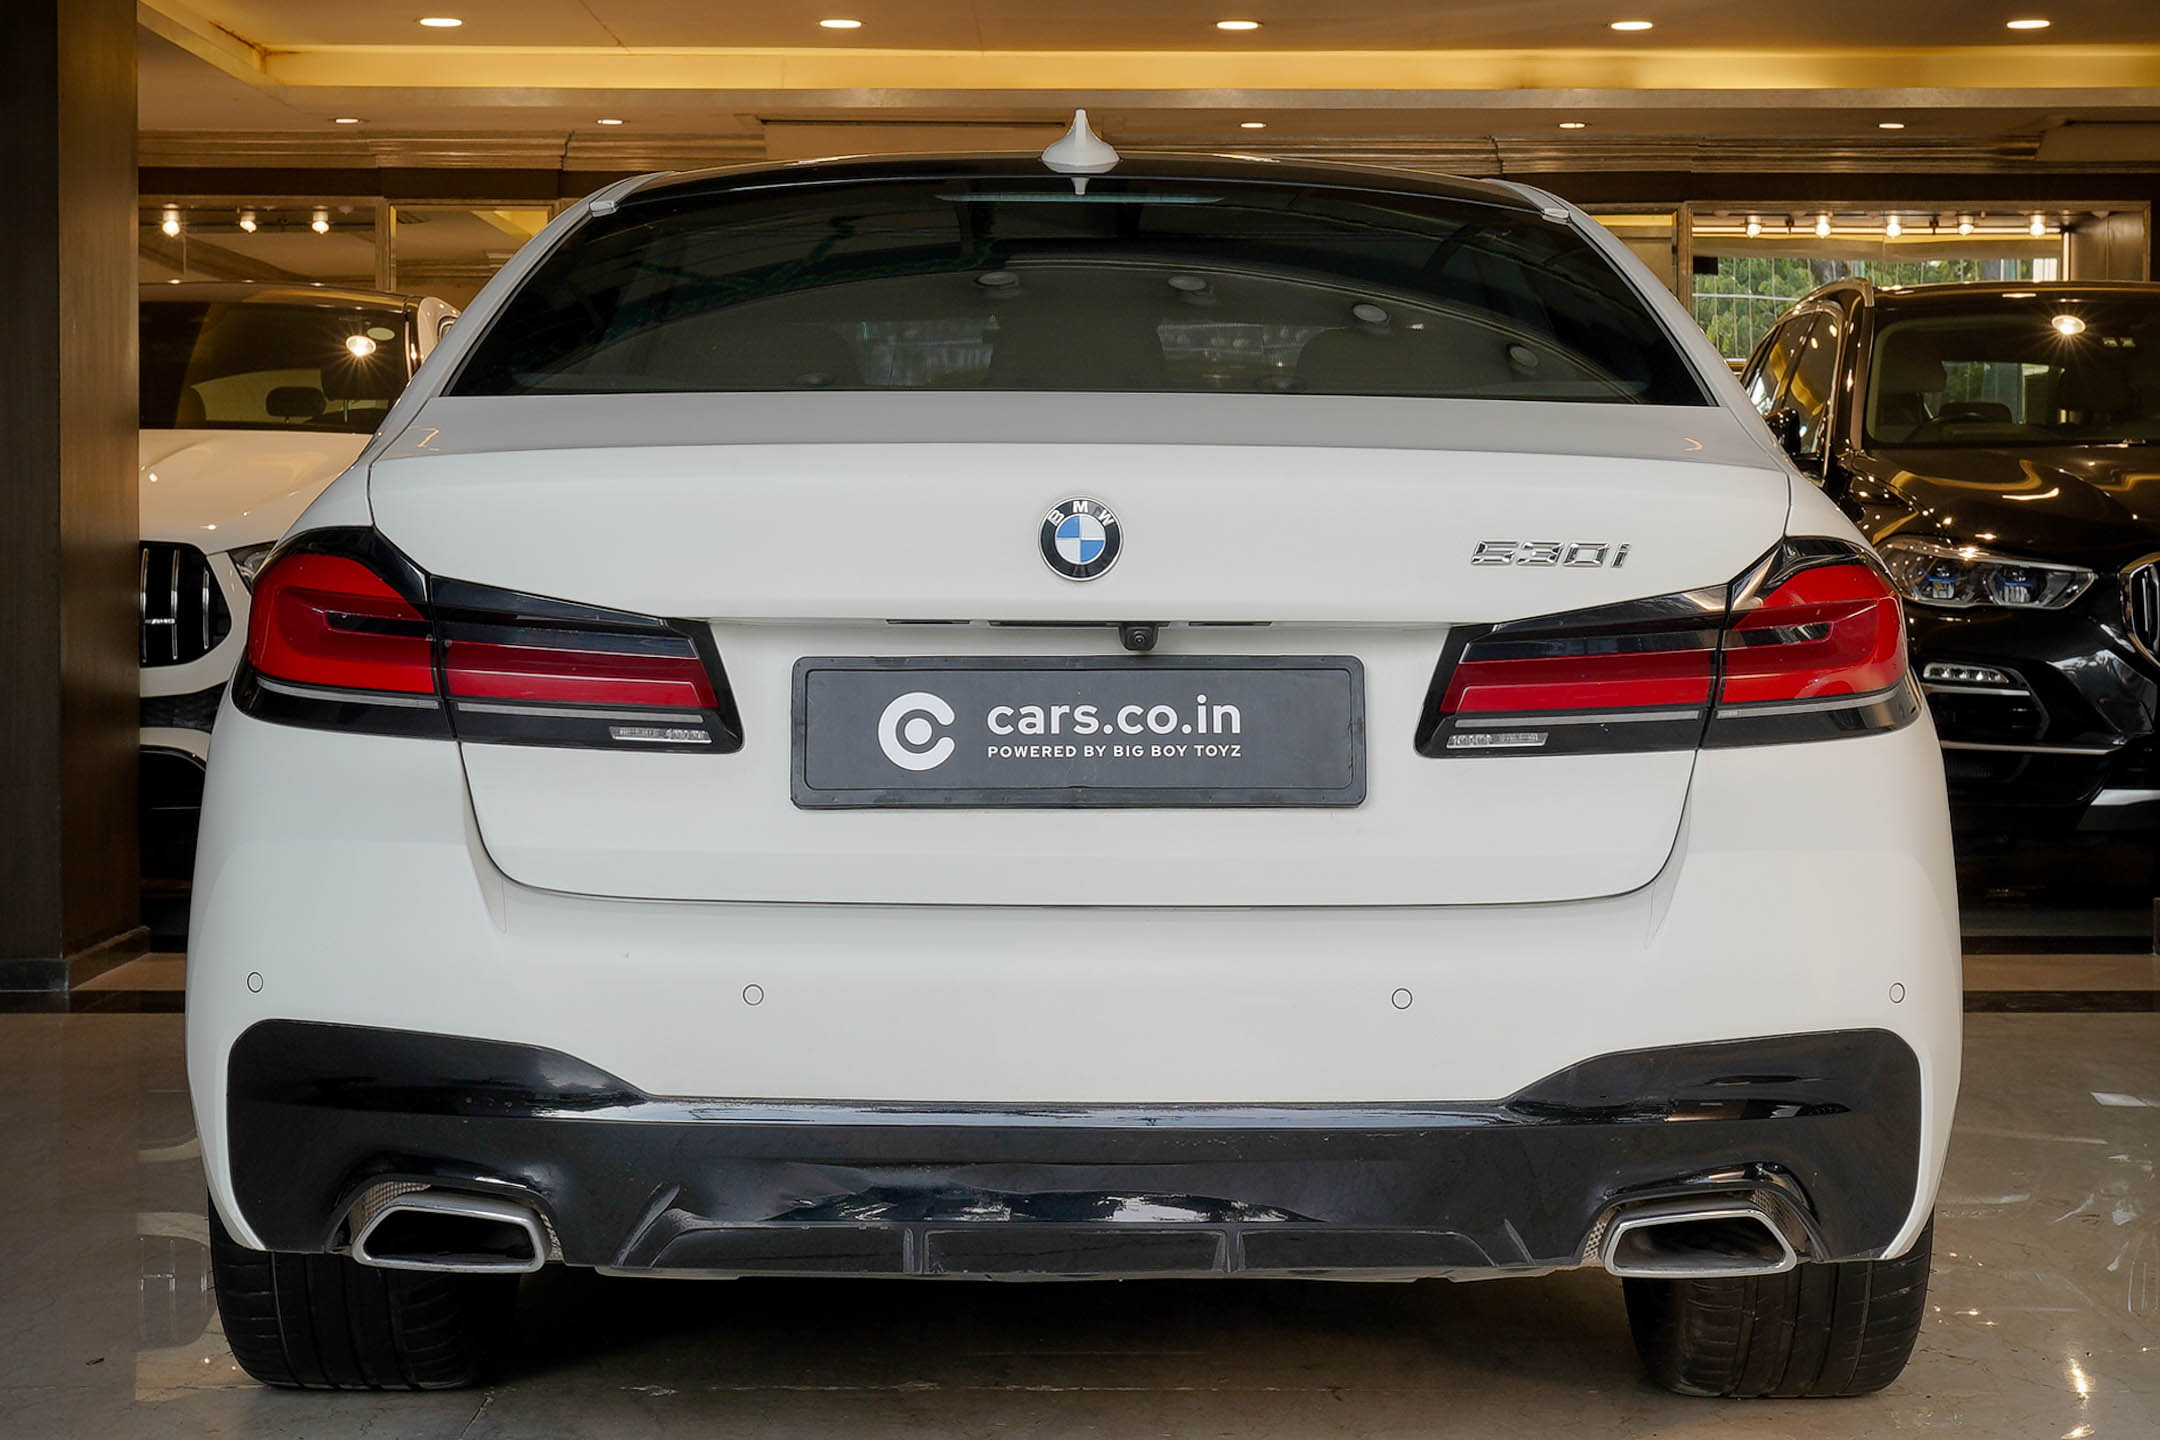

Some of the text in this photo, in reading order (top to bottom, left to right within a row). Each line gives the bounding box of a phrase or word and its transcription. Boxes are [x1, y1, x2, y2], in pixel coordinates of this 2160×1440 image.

[1047, 500, 1116, 526] BMW
[1470, 540, 1632, 568] 530i
[986, 693, 1242, 736] cars.co.in
[987, 744, 1242, 758] POWERED BY BIG BOY TOYZ
